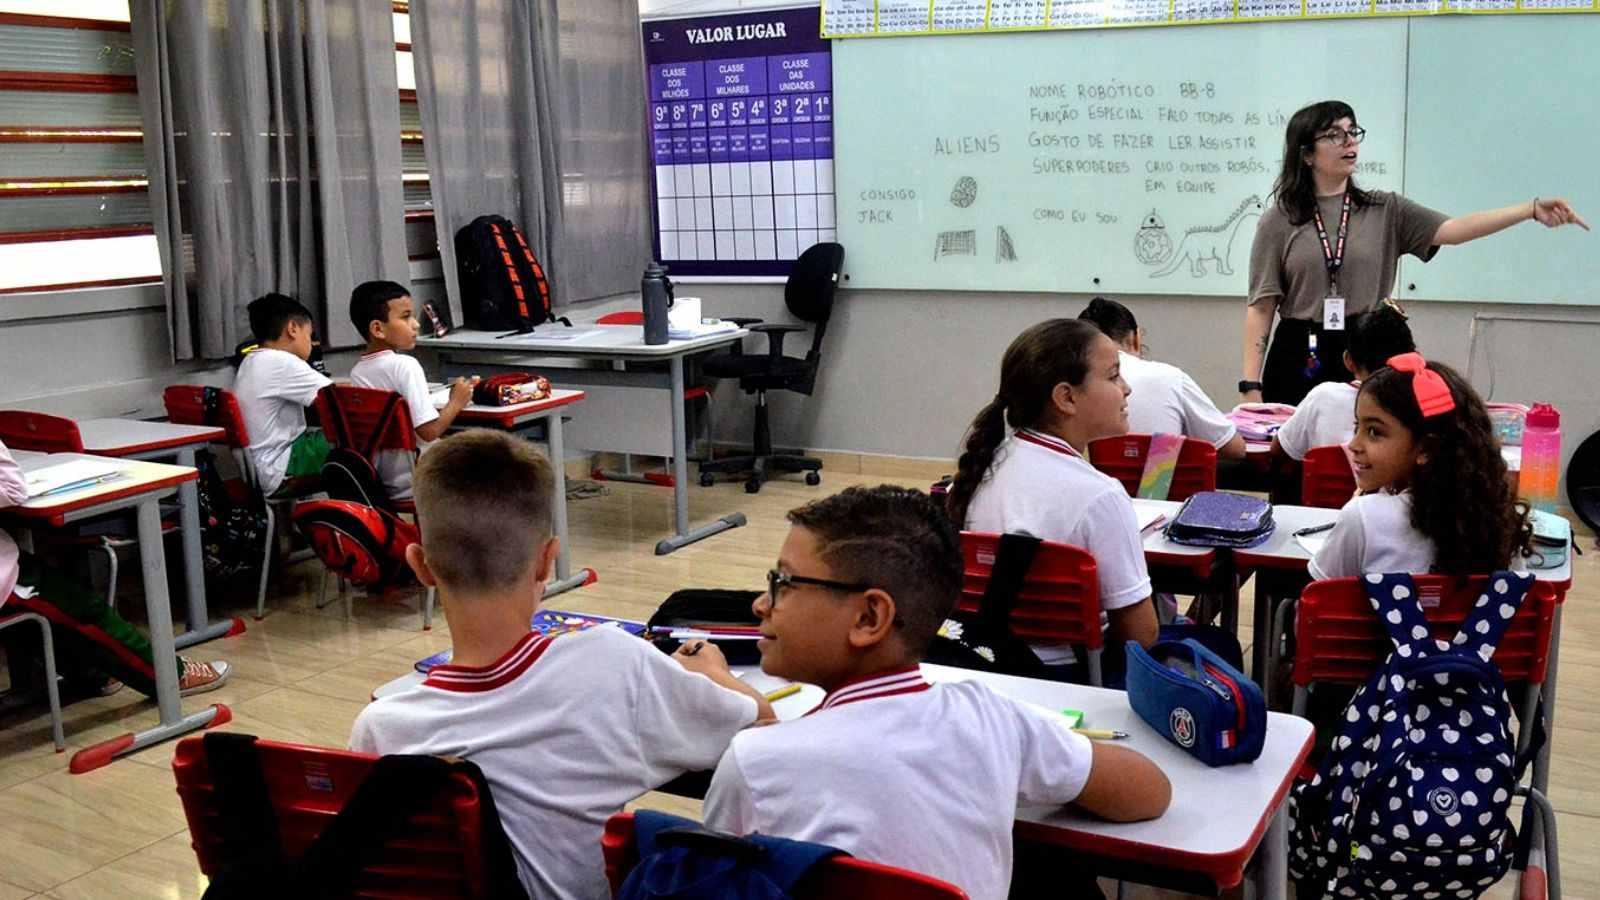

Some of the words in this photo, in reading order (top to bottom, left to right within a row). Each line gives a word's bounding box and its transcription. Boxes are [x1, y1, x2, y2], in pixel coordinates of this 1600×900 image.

[686, 27, 734, 44] VALOR
[736, 21, 787, 41] LUGAR
[718, 63, 745, 74] CLASSE
[781, 58, 809, 69] CLASSE
[661, 67, 688, 78] CLASSE
[724, 75, 740, 84] DOS
[779, 80, 815, 92] UNIDADES
[1028, 84, 1067, 99] NOME
[1030, 103, 1079, 125] FUNÇÃO
[1087, 104, 1144, 120] ESPECIAL
[1244, 112, 1260, 126] AS
[934, 134, 1000, 155] ALIENS
[1028, 131, 1080, 149] GOSTO
[1087, 133, 1105, 149] DE
[1112, 133, 1155, 150] FAZER
[1199, 135, 1257, 150] ASSISTIR
[1145, 180, 1167, 192] EM
[1175, 179, 1217, 194] EQUIPE
[859, 188, 916, 201] CONSIGO
[857, 209, 894, 225] JACK
[1032, 207, 1065, 221] COMO
[1071, 209, 1087, 223] EU
